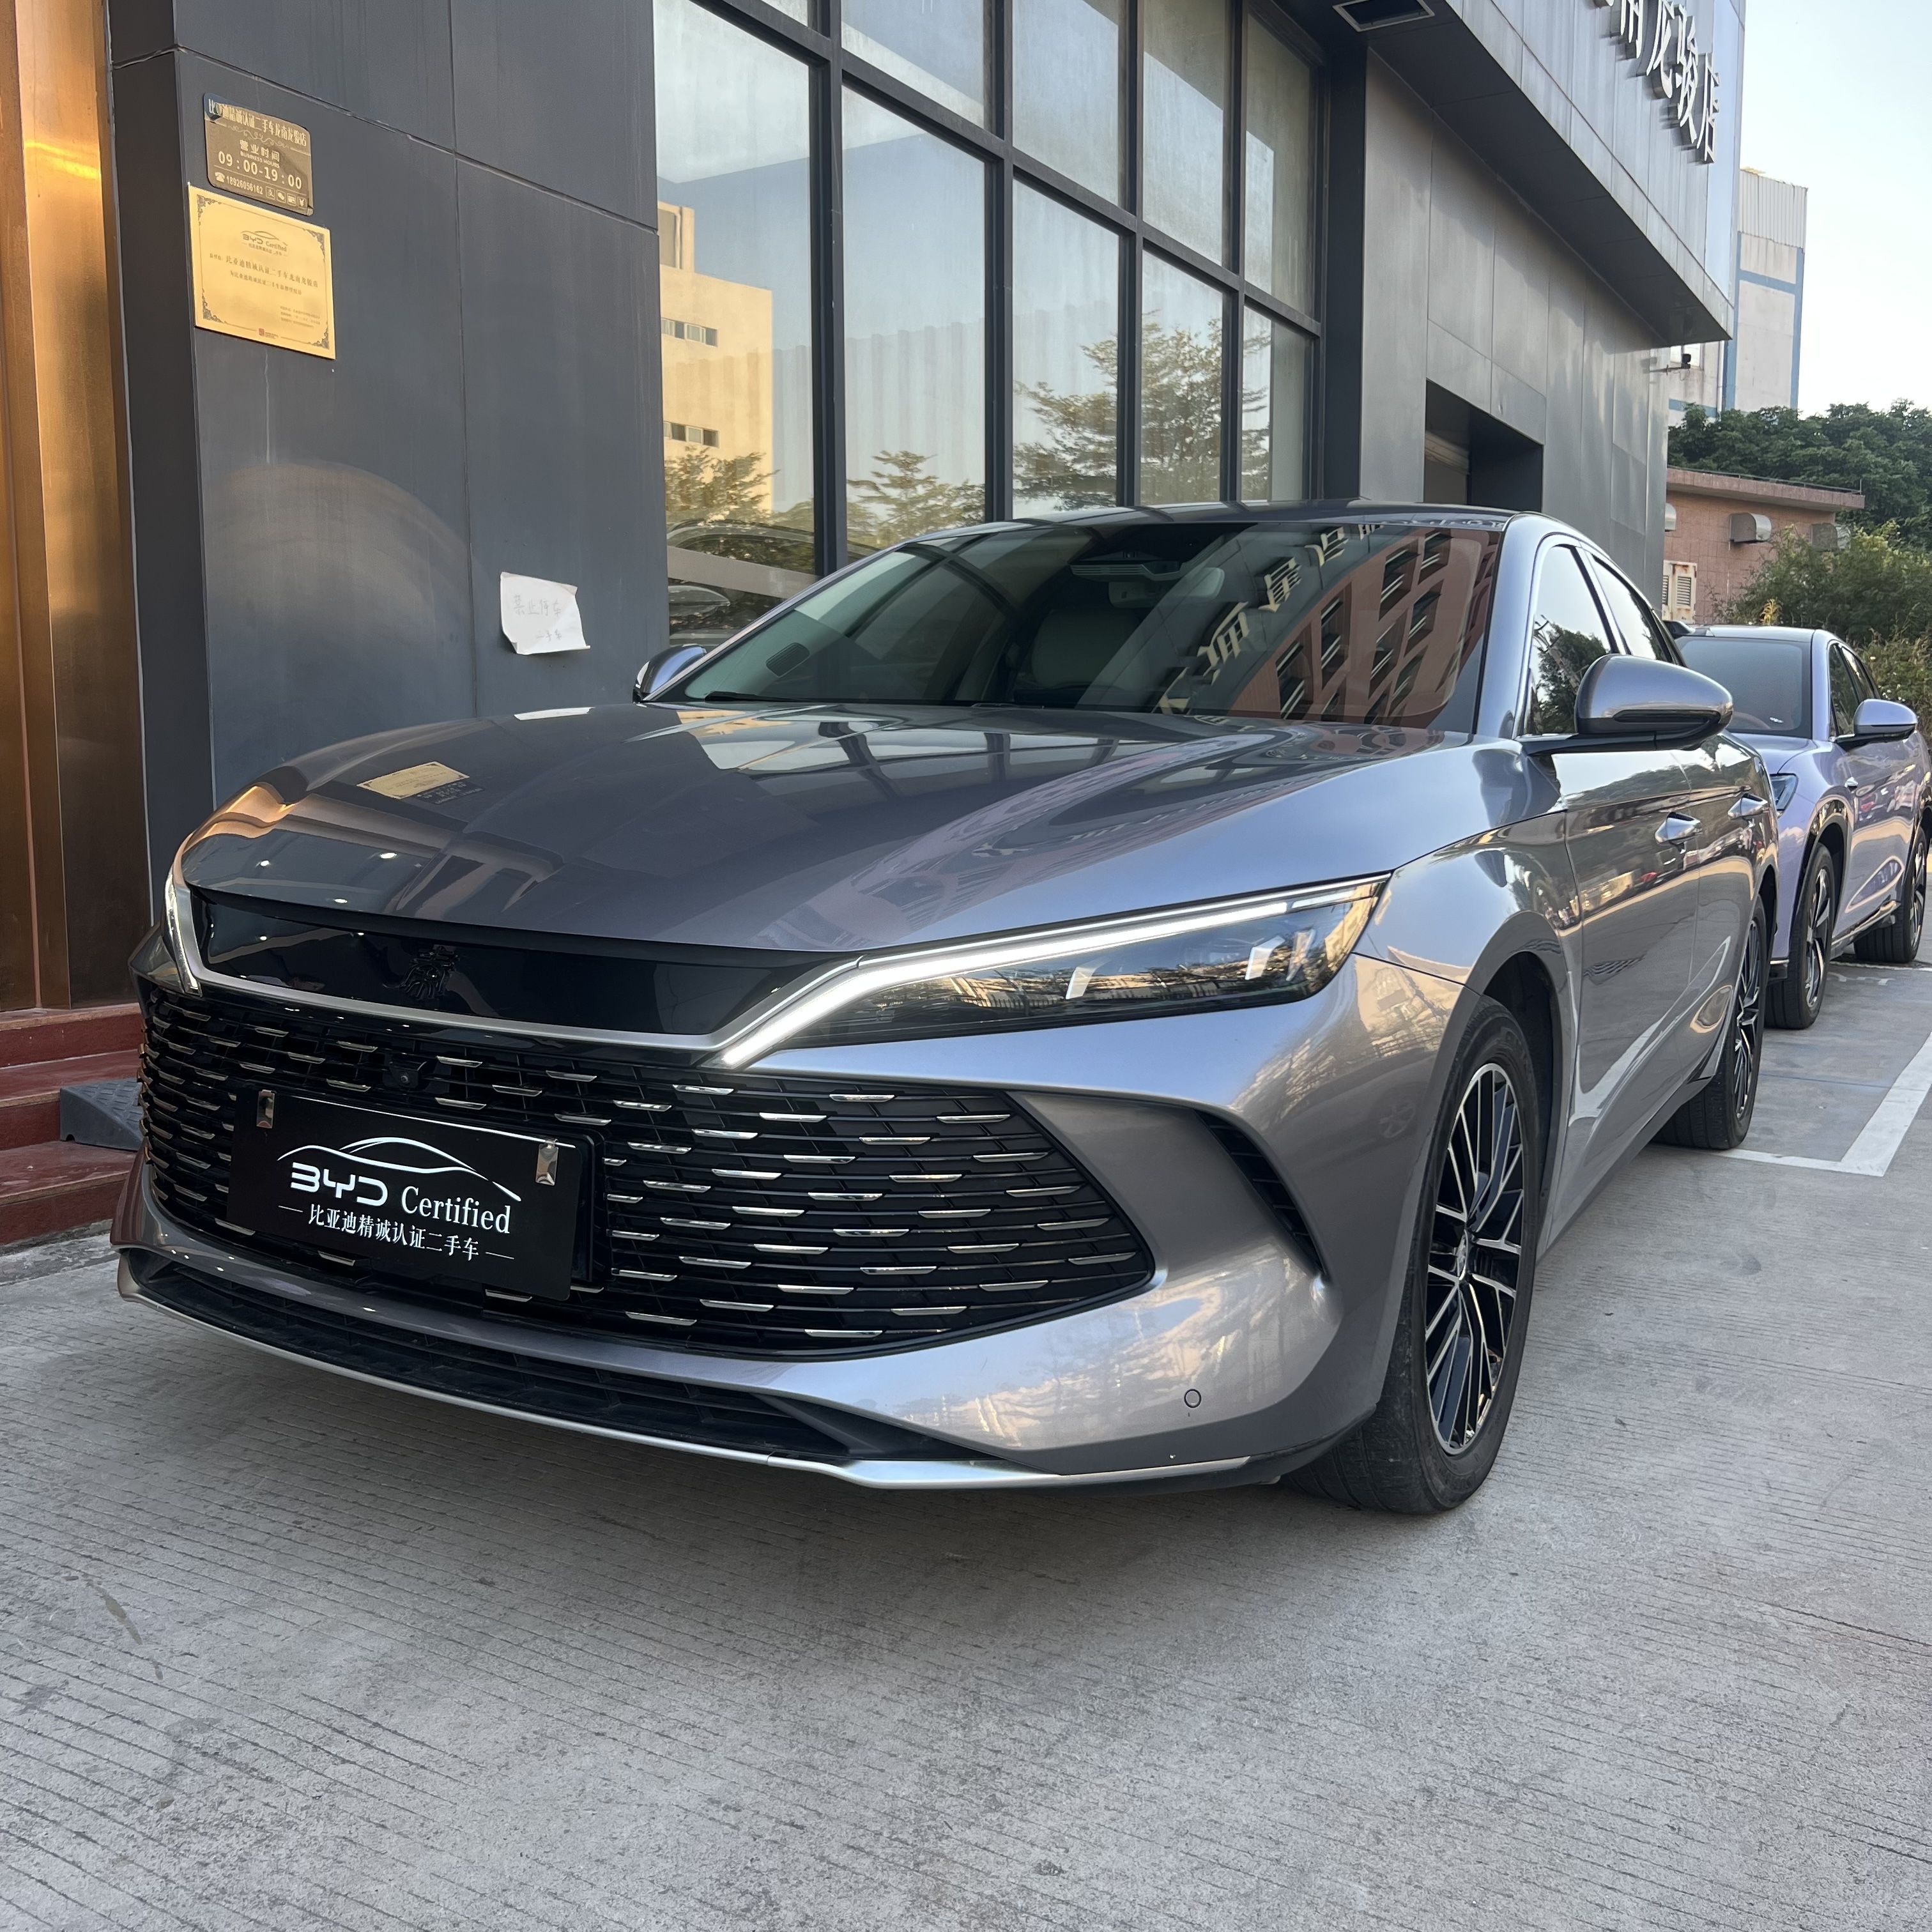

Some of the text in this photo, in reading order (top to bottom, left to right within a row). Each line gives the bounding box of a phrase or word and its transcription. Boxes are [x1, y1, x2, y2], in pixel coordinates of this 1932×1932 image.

[240, 139, 280, 162] 营业时间
[240, 151, 280, 169] BUSINESS HOURS
[242, 234, 263, 245] BYD
[266, 241, 287, 252] Certified
[513, 595, 562, 617] 禁止停车
[290, 1162, 511, 1234] BYD Certified
[308, 1204, 480, 1262] 比亚迪精诚认证二手车
